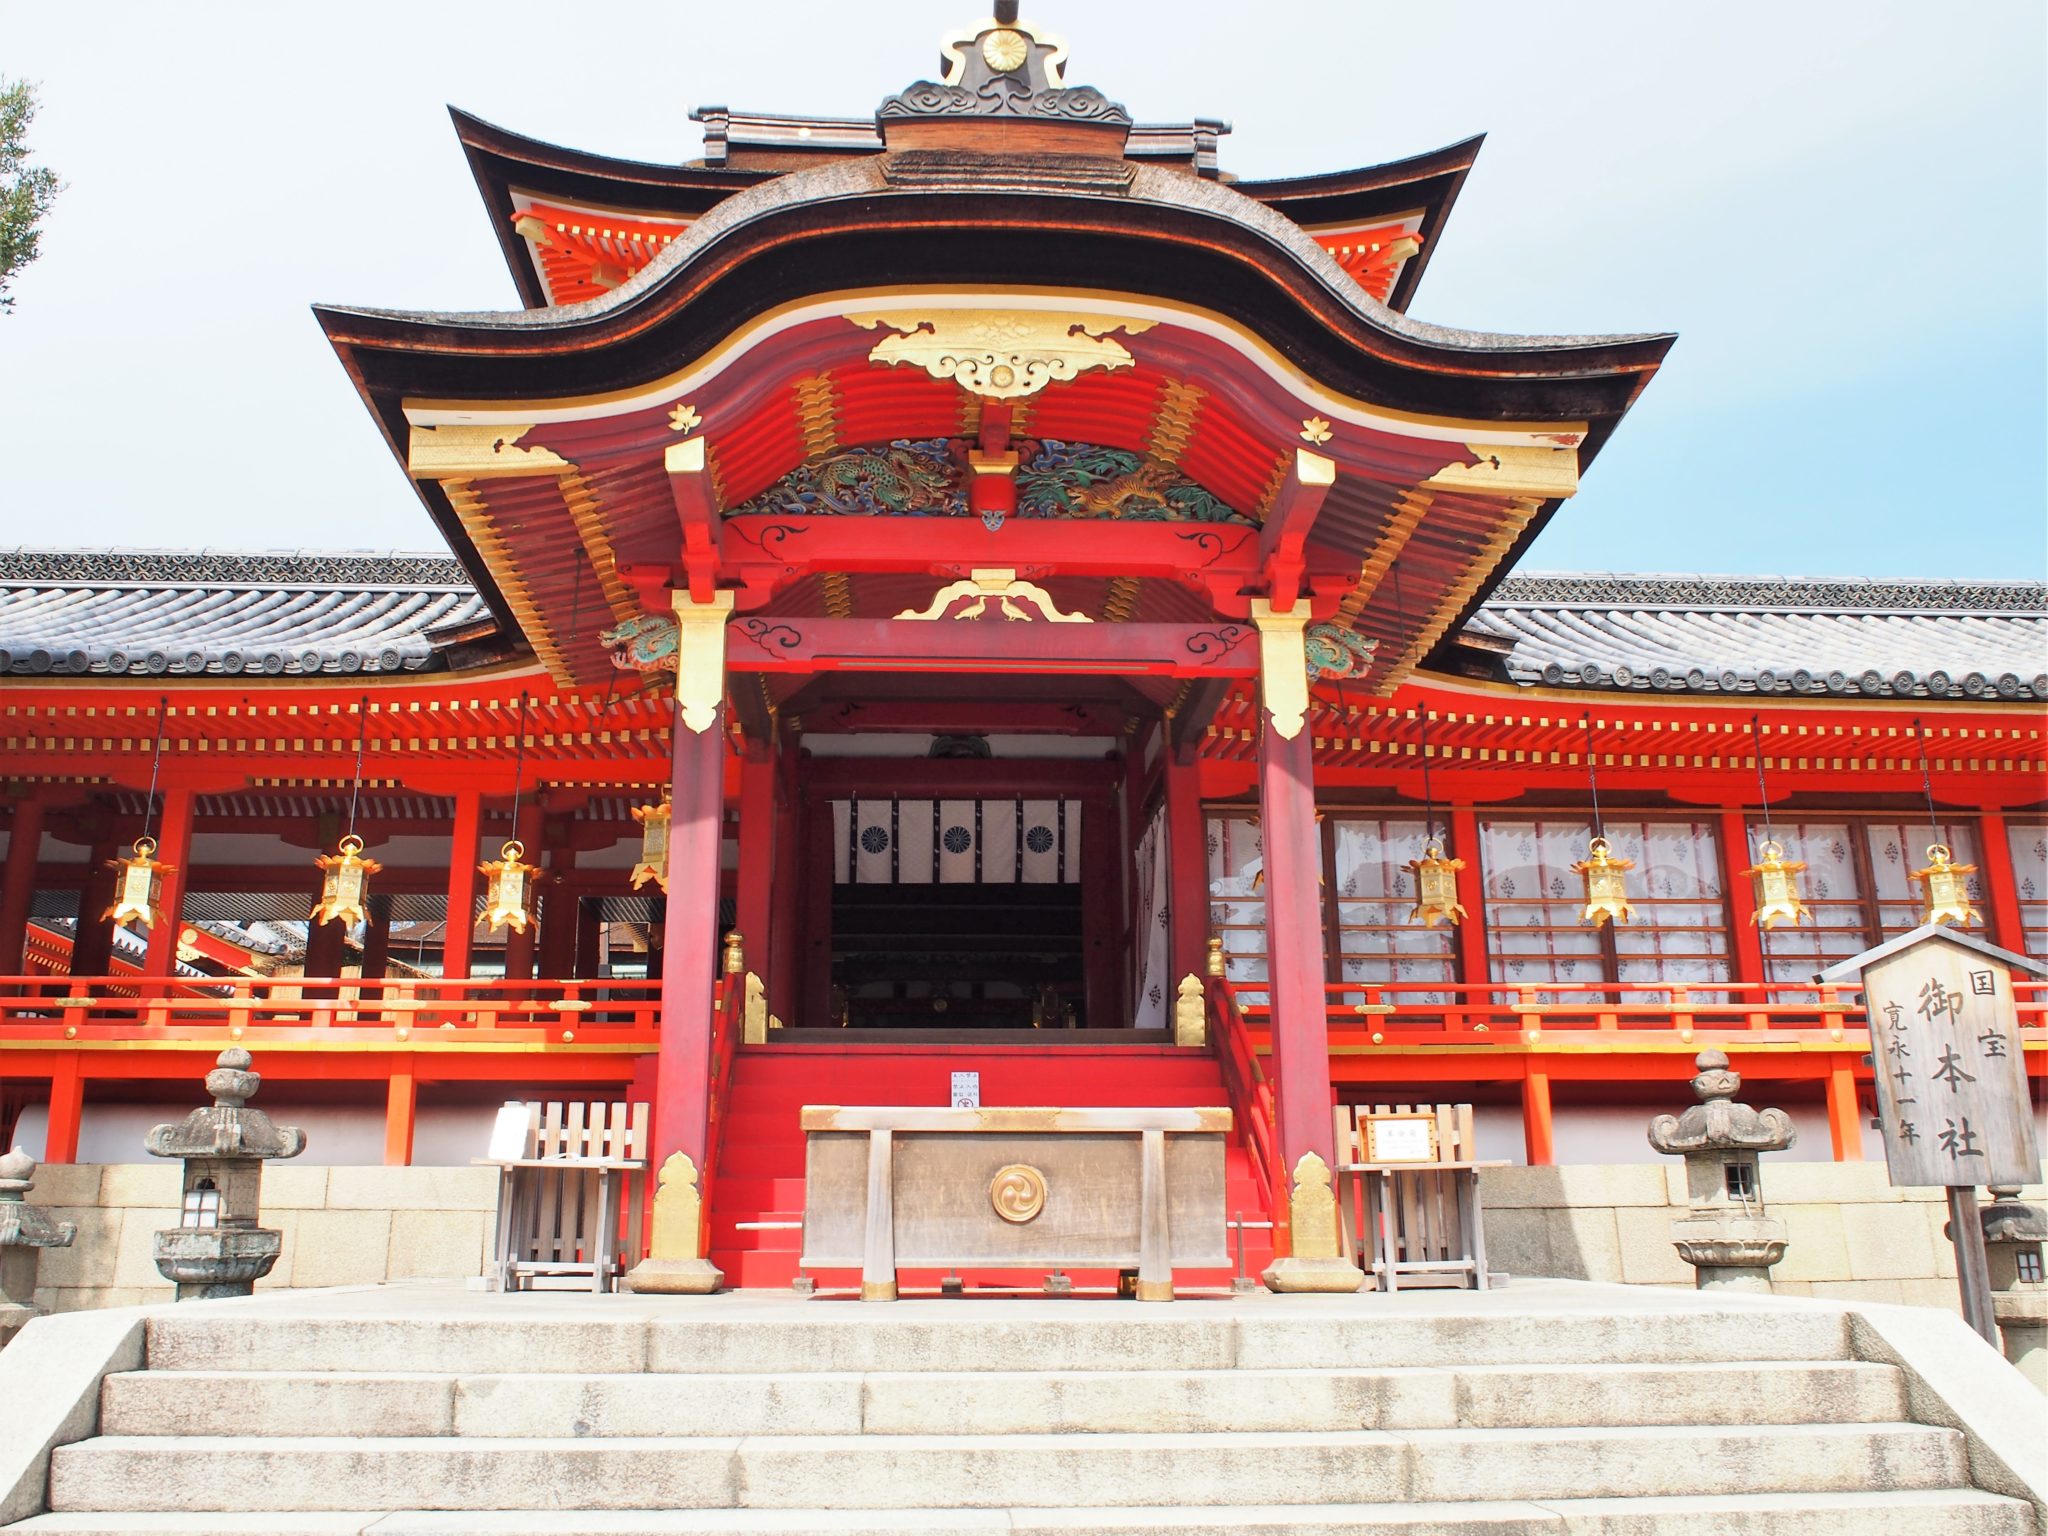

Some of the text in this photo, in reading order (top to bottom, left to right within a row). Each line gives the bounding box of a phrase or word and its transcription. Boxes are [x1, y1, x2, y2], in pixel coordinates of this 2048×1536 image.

[1882, 1000, 1921, 1147] 寛永十一年
[1916, 976, 1985, 1161] 御本社
[1968, 969, 2008, 1059] 国宝
